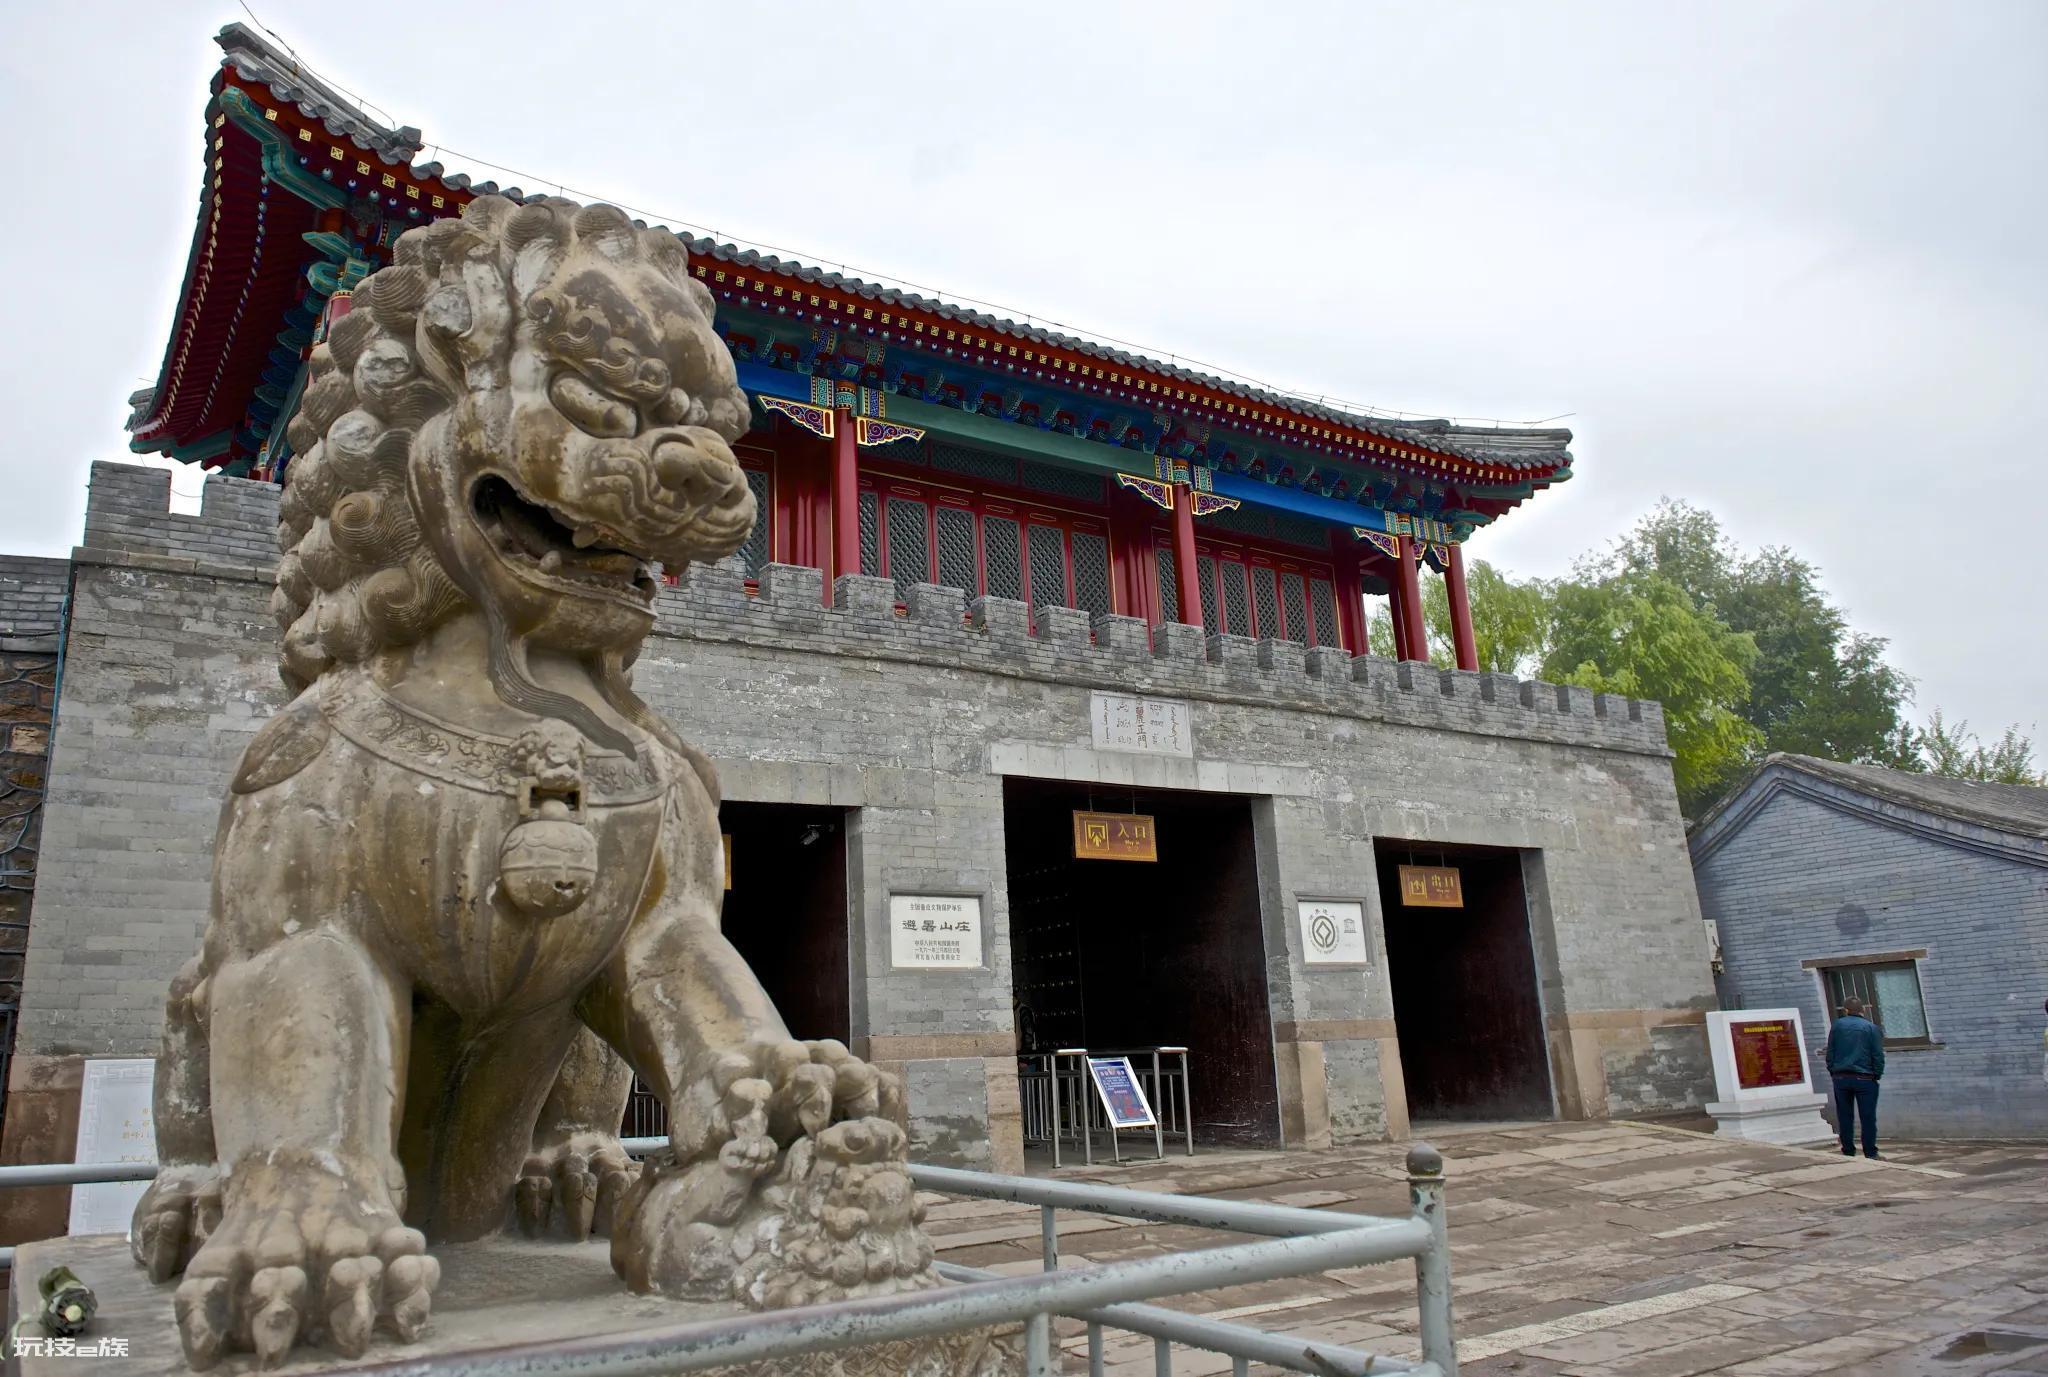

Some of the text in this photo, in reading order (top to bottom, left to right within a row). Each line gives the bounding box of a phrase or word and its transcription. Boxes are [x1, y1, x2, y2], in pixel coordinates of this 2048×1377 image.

[1118, 822, 1146, 839] 入口
[1431, 874, 1454, 888] 出口
[902, 919, 971, 933] 避暑山庄
